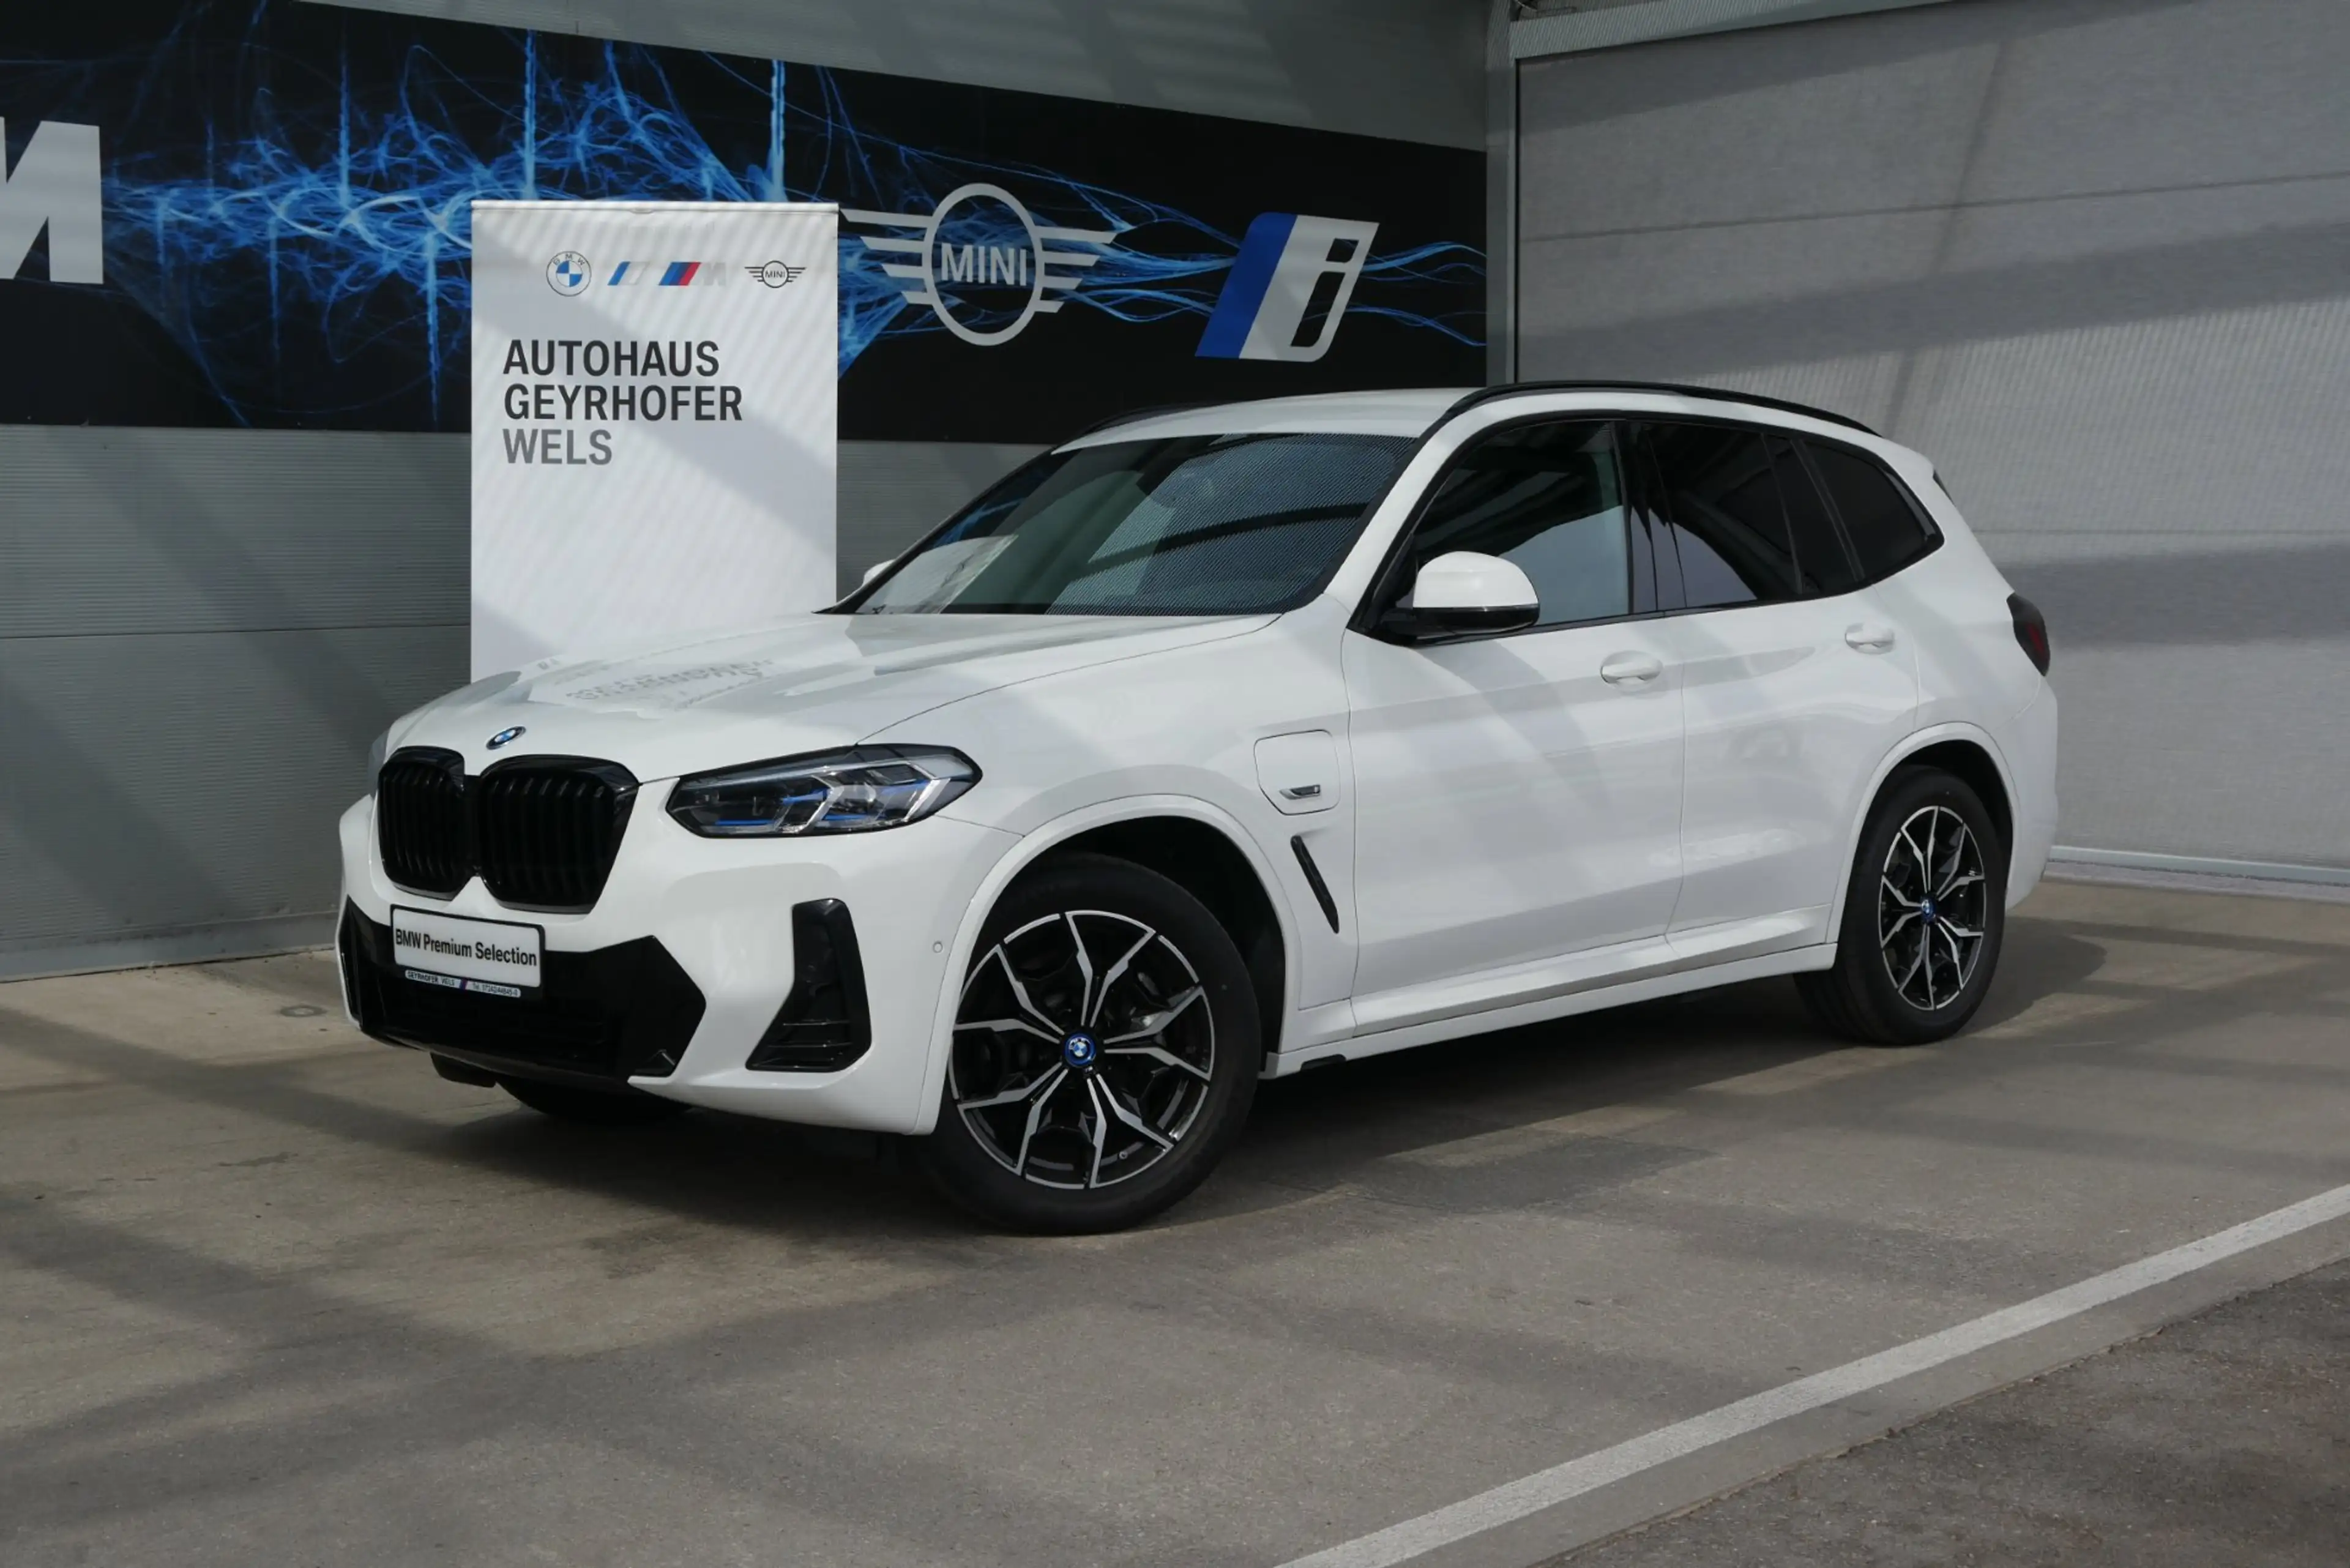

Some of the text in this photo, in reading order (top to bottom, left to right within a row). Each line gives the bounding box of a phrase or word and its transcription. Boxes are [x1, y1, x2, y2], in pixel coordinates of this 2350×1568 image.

[765, 270, 786, 279] MINI
[939, 242, 1029, 286] MINI
[503, 339, 720, 376] AUTOHAUS
[504, 383, 743, 421] GEYRHOFER
[503, 428, 613, 465] WELS
[395, 928, 537, 966] BMW Premium Selection
